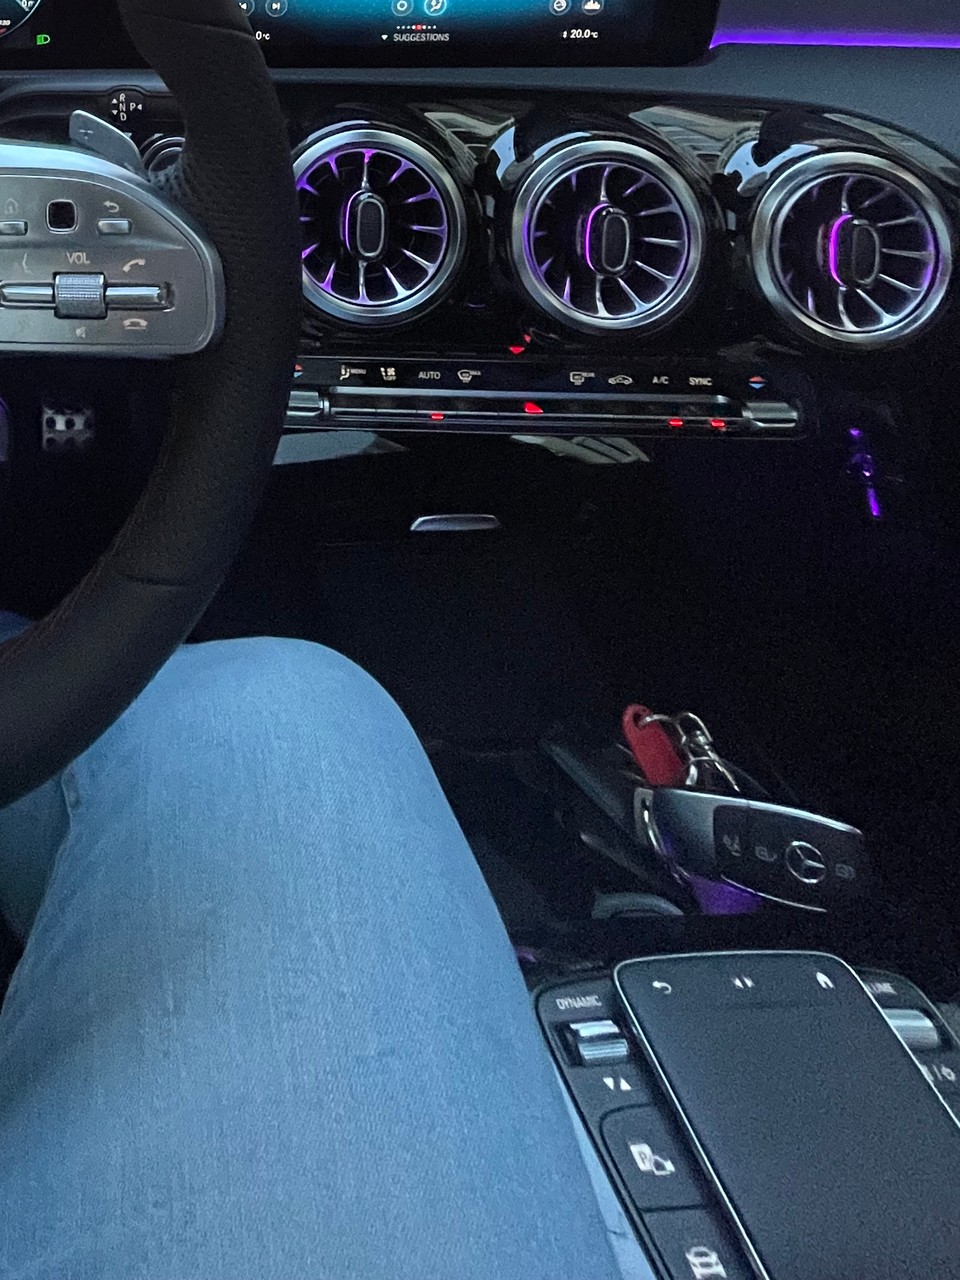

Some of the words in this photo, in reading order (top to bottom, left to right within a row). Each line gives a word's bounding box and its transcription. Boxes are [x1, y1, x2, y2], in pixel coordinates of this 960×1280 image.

[393, 33, 449, 41] SUGGESTIONS
[119, 93, 126, 102] R
[119, 102, 126, 112] N
[130, 102, 136, 111] P
[120, 112, 127, 121] D
[66, 252, 90, 264] VOL
[418, 371, 440, 380] AUTO
[652, 376, 669, 384] A/C
[689, 377, 712, 386] SYNC
[555, 995, 602, 1010] DYNAMIC
